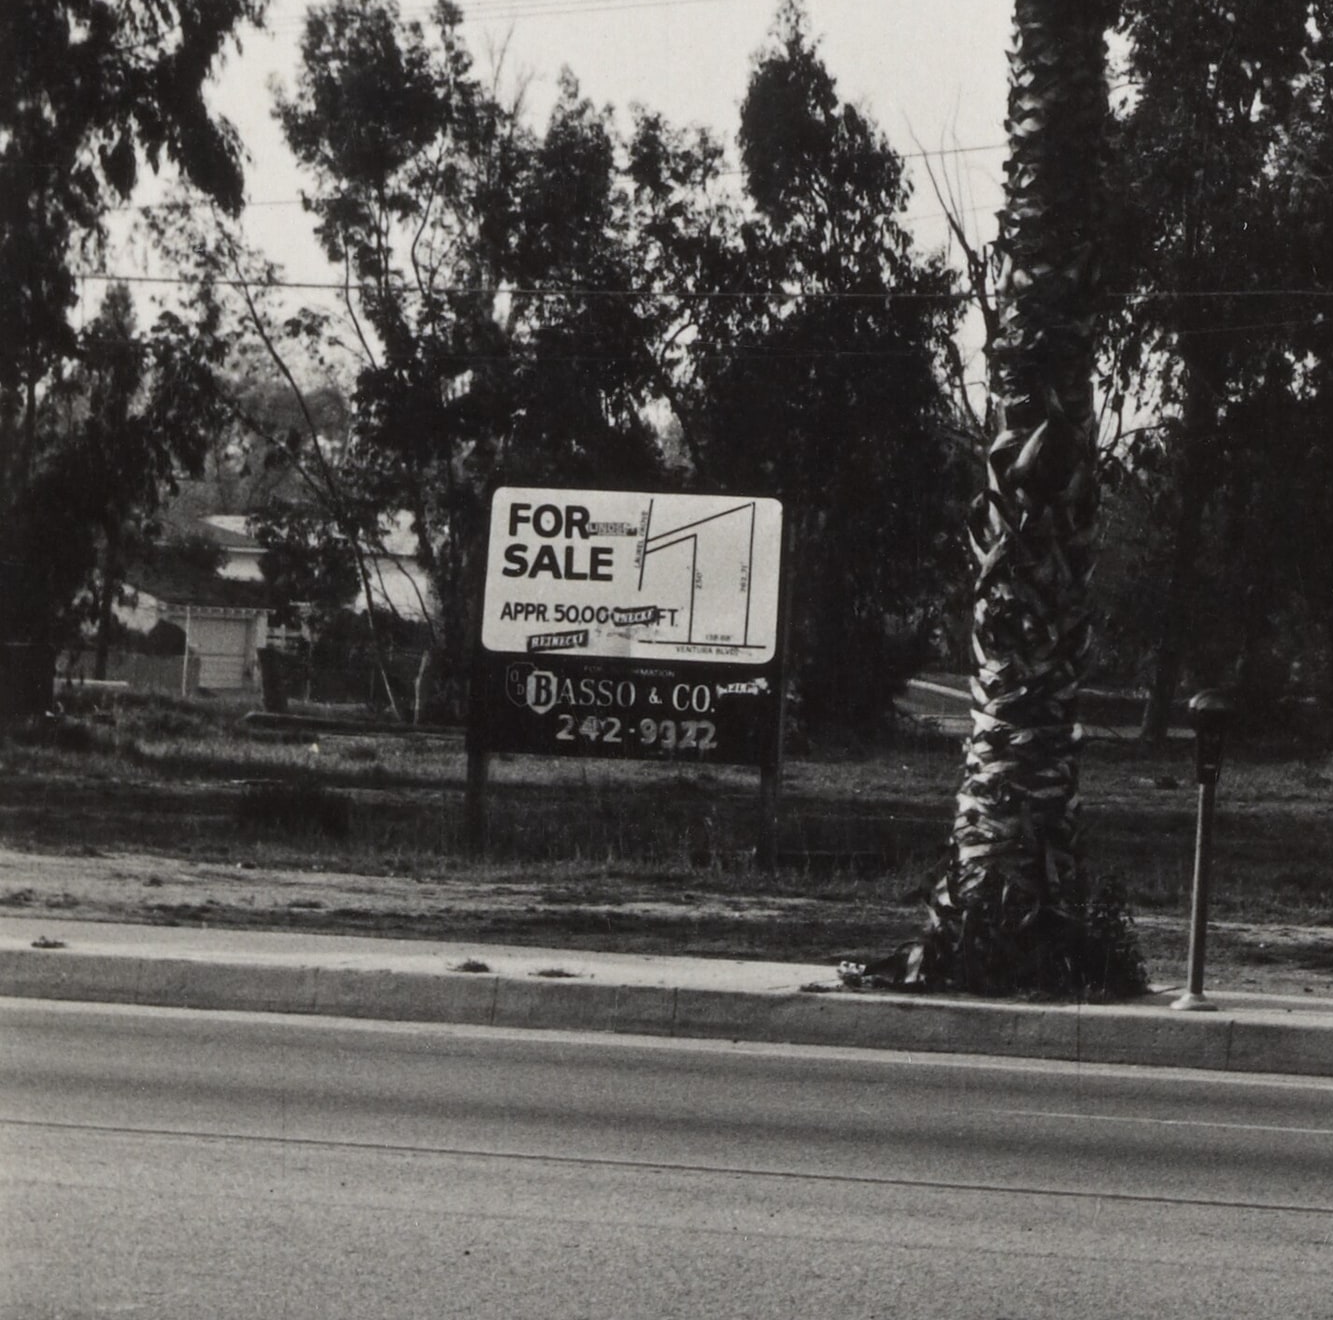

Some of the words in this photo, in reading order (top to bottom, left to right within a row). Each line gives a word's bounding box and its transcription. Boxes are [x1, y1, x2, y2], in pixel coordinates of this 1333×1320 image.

[509, 503, 590, 539] FOR
[502, 544, 614, 581] SALE
[500, 602, 549, 622] APPR.
[676, 646, 712, 654] VENTURA
[534, 674, 636, 707] BASSO
[649, 687, 662, 704] &
[673, 684, 716, 713] CO.
